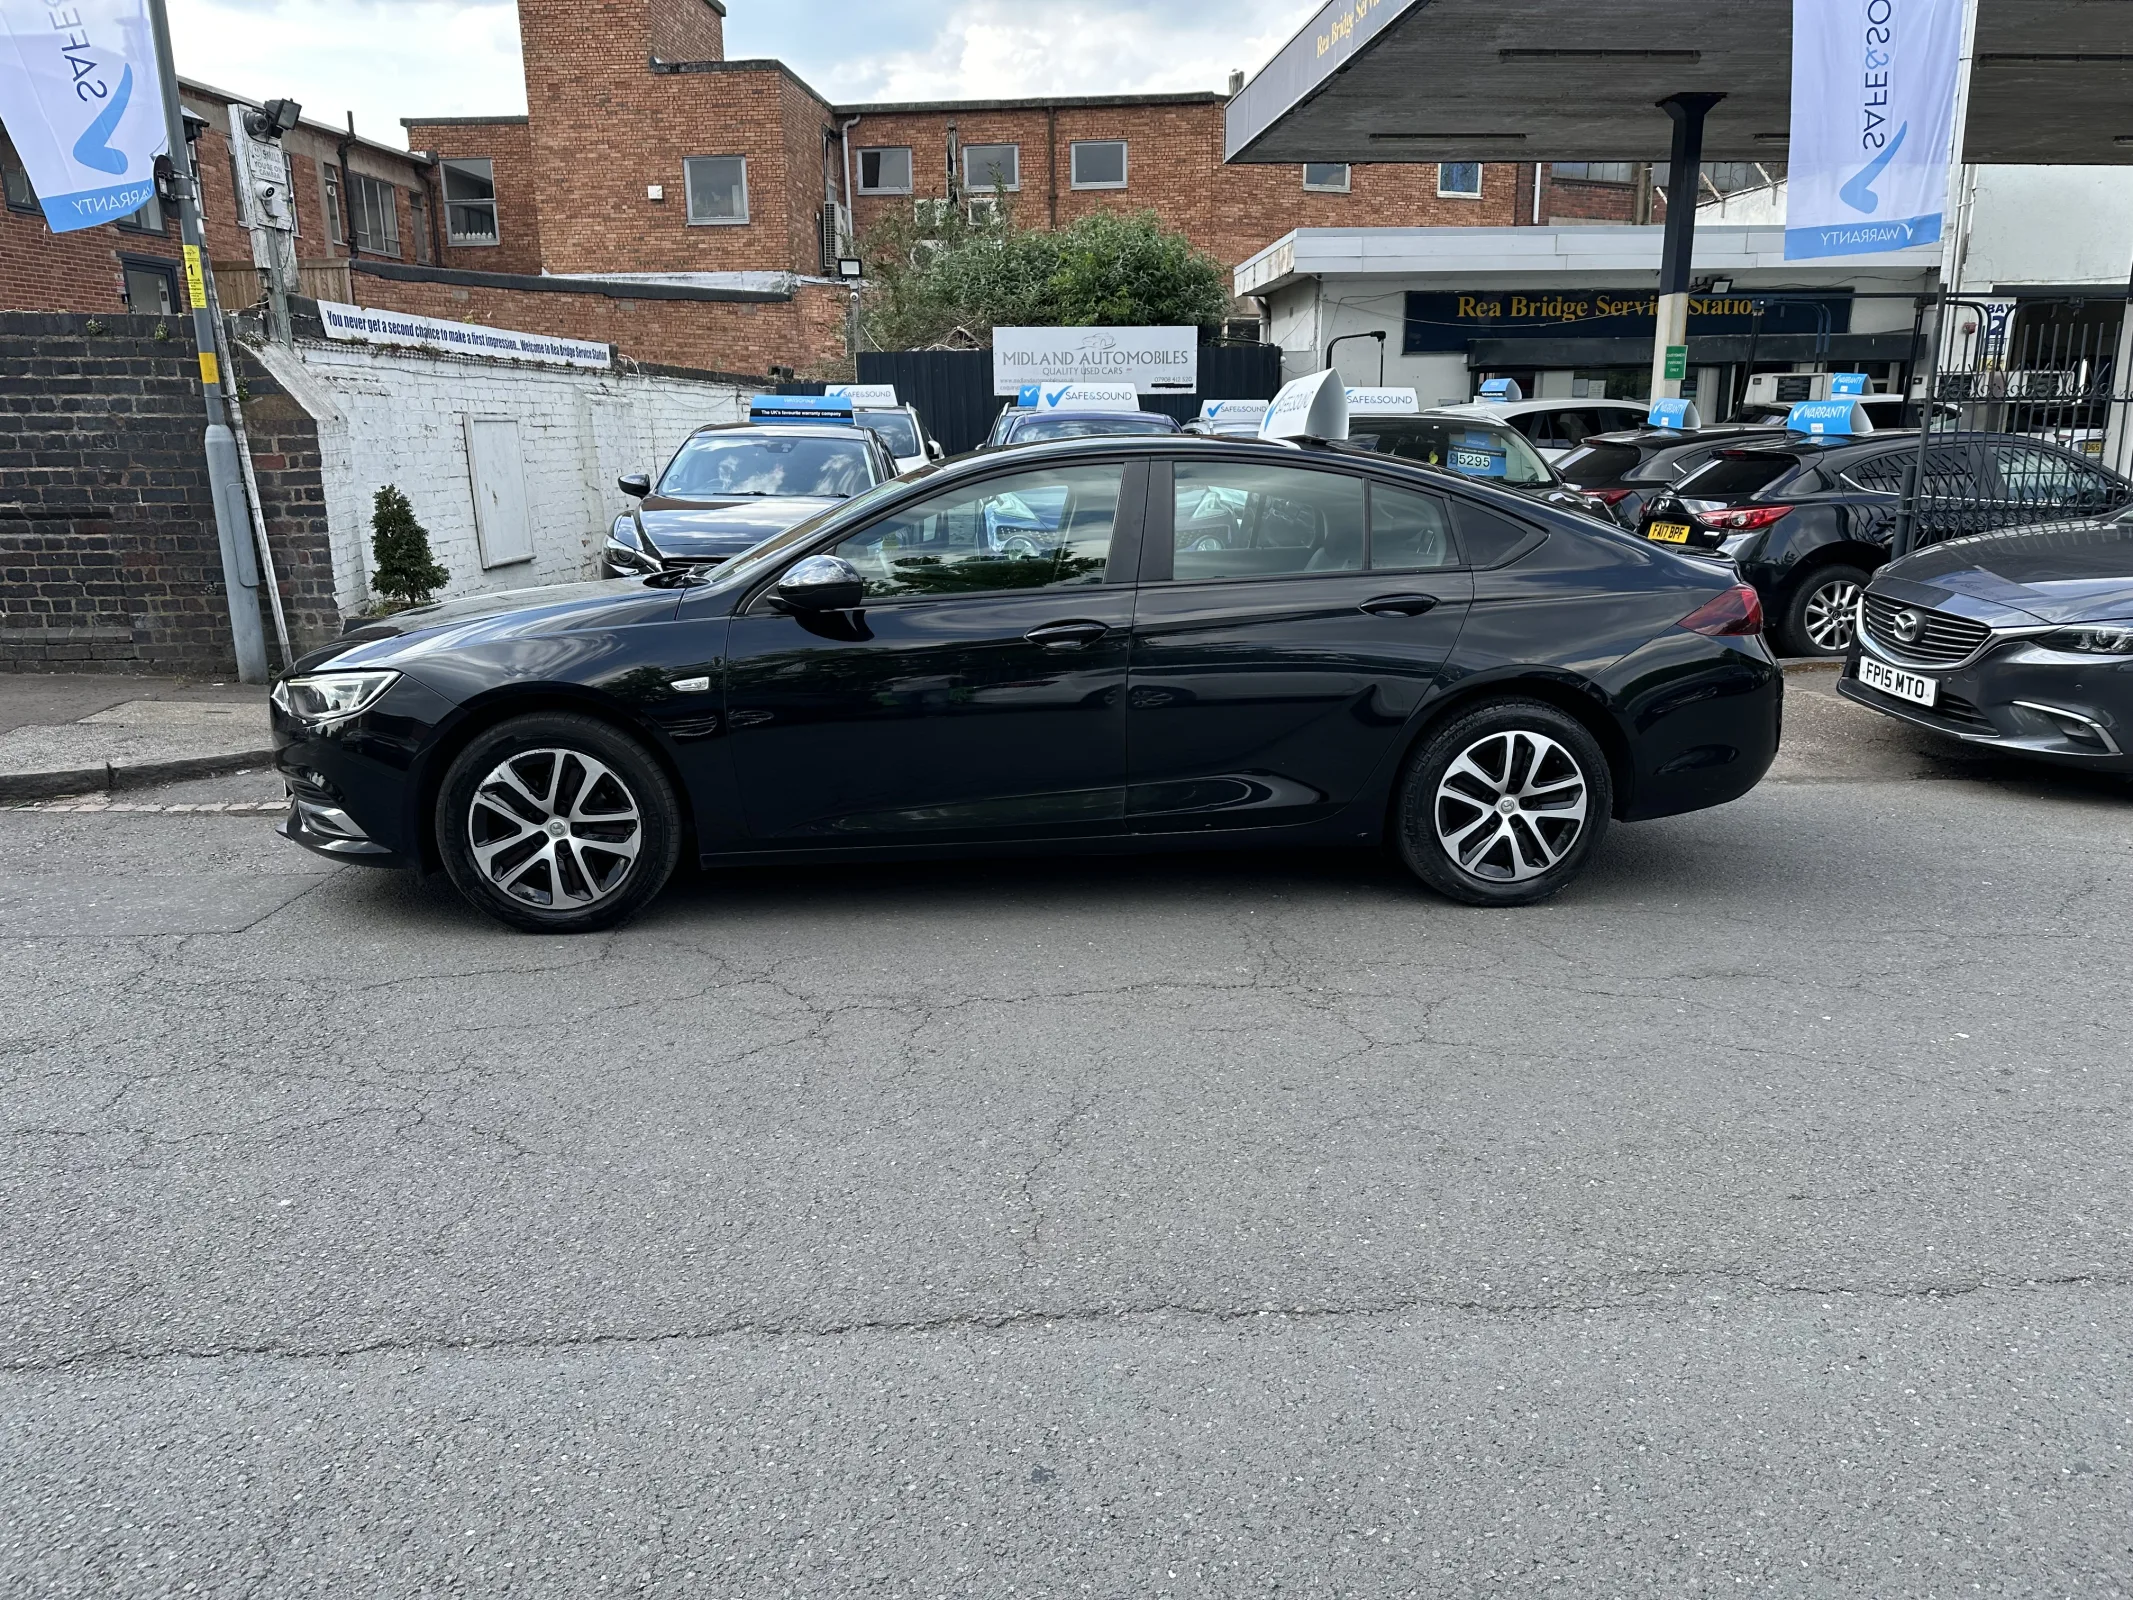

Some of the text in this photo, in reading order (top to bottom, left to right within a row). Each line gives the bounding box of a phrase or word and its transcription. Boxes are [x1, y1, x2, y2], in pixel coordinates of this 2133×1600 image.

[1316, 35, 1330, 59] Rea
[1331, 11, 1354, 46] Bridge
[1457, 296, 1501, 317] Rea
[1511, 296, 1588, 322] Bridge
[1687, 297, 1764, 315] Statio
[1988, 304, 2014, 313] BAY
[327, 310, 342, 327] You
[344, 315, 366, 331] never
[368, 319, 380, 333] get
[382, 322, 387, 333] a
[388, 323, 414, 337] second
[415, 325, 440, 341] chance
[440, 329, 447, 341] to
[449, 330, 466, 344] make
[467, 334, 471, 344] a
[472, 332, 485, 346] first
[520, 339, 545, 354] Welcome
[545, 343, 550, 354] to
[551, 343, 560, 356] Rea
[560, 344, 575, 358] Bridge
[576, 346, 592, 359] Service
[592, 348, 607, 360] Station
[1003, 351, 1188, 366] MIDLAND AUTOMOBILES
[1042, 367, 1123, 376] QUALITY USED CARS
[1065, 391, 1132, 401] SAFE&SOUND
[1347, 395, 1413, 404] SAFE&SOUND
[1220, 405, 1267, 413] SAFE&SOUND
[1804, 406, 1850, 418] WARRANTY
[1668, 526, 1685, 540] BPF
[1866, 661, 1925, 698] FP15 MTO
